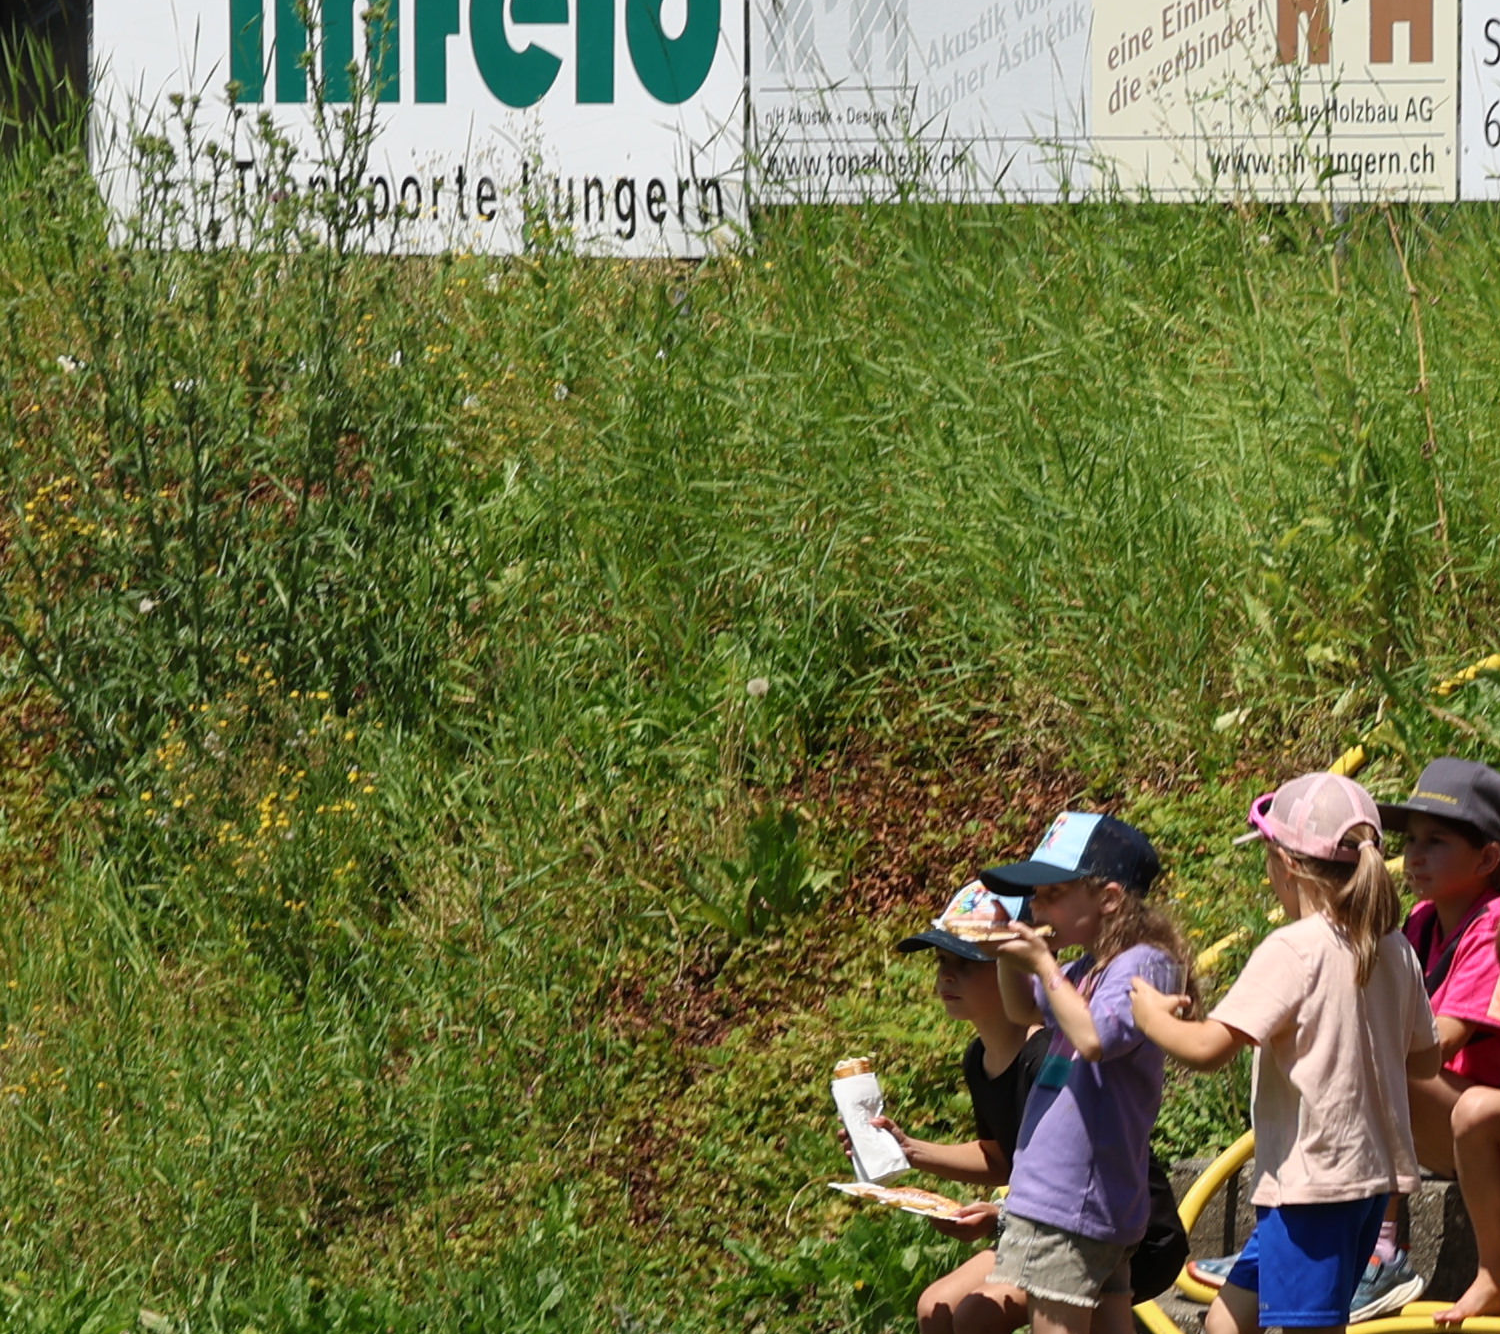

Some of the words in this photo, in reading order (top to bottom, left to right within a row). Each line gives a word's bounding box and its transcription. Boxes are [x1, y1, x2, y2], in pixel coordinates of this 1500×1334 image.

[926, 1, 1007, 73] Akustik
[1107, 25, 1154, 71] eine
[1107, 76, 1142, 116] die
[1325, 97, 1398, 124] Holzbau
[1405, 96, 1433, 123] AG
[235, 160, 498, 235] Tnporte
